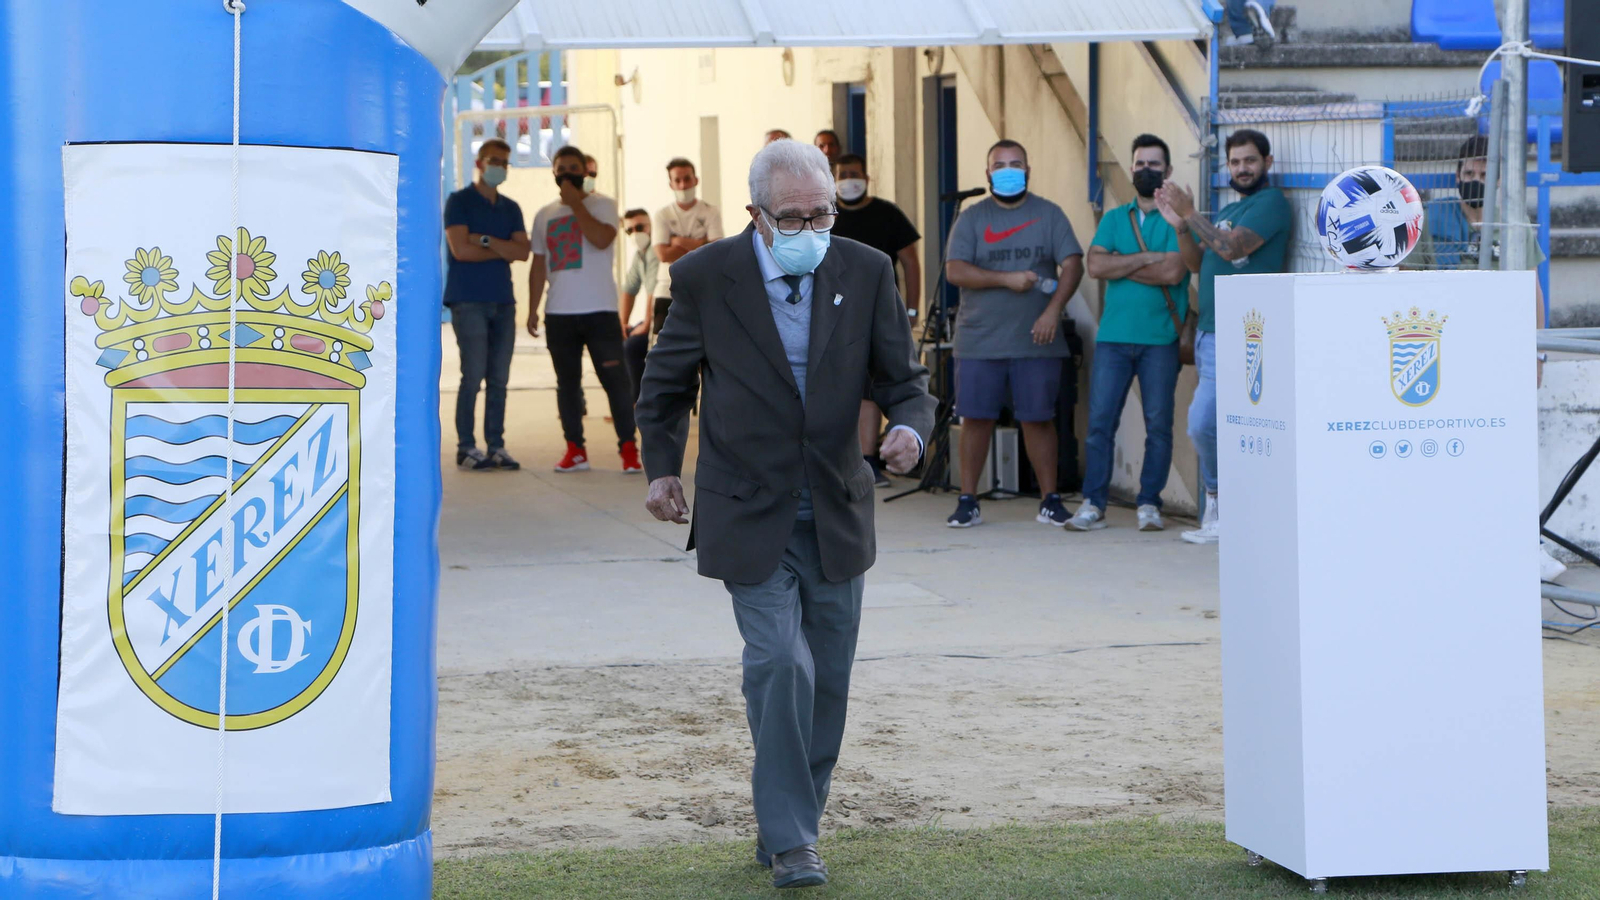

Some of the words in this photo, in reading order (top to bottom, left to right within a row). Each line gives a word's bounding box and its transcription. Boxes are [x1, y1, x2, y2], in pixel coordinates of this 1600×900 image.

[988, 248, 1012, 261] JUST
[1014, 246, 1031, 260] DO
[1397, 342, 1436, 390] XEREZ
[1226, 414, 1286, 431] XEREZCLUBDEPORTIVO.ES
[1327, 417, 1506, 432] XEREZCLUBDEPORTIVO.ES
[146, 413, 337, 647] XEREZ
